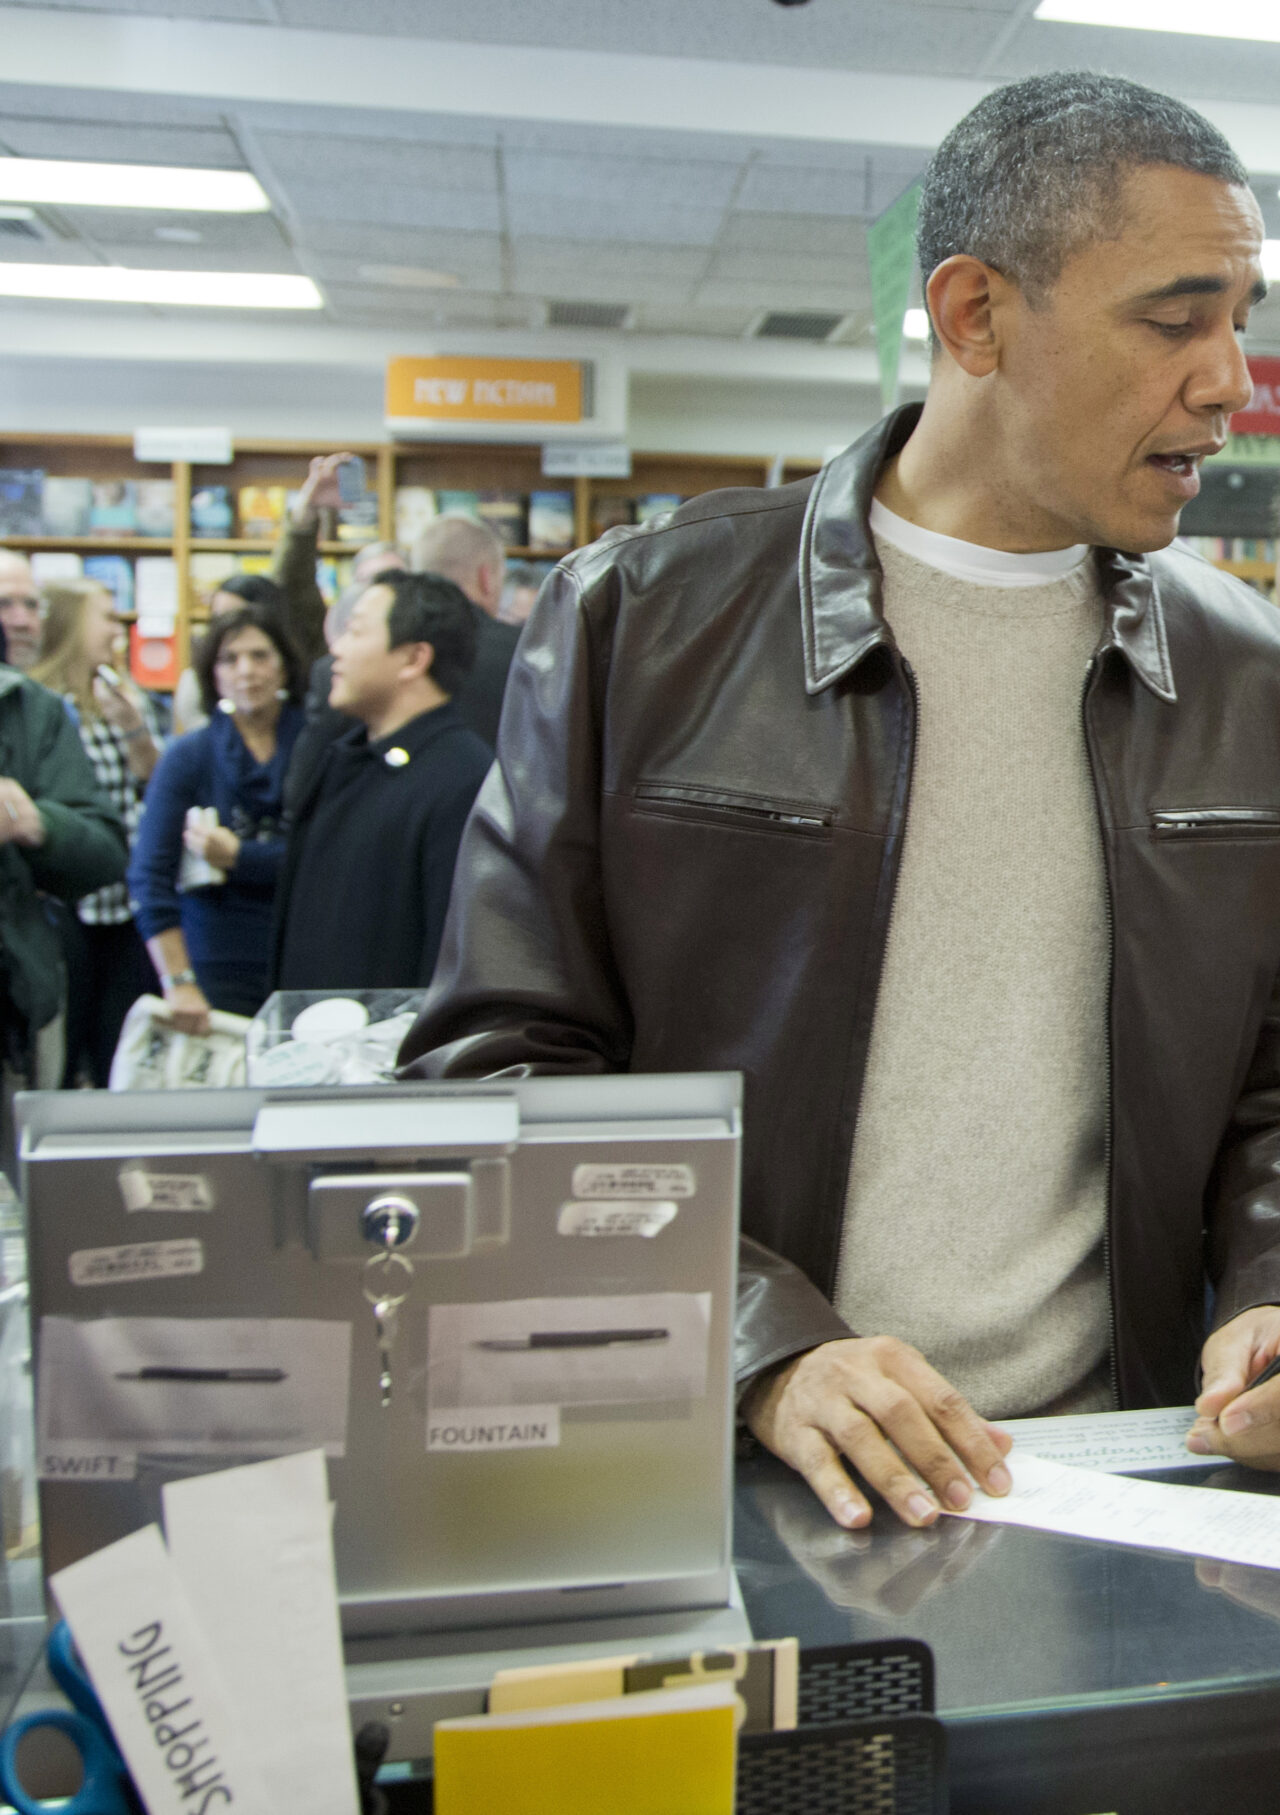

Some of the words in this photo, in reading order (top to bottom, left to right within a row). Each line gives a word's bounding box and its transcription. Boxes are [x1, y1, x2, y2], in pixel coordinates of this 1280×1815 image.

[413, 377, 468, 405] NEW
[473, 379, 557, 407] FICTION
[429, 1423, 548, 1445] FOUNTAIN
[44, 1454, 118, 1474] SWIFT
